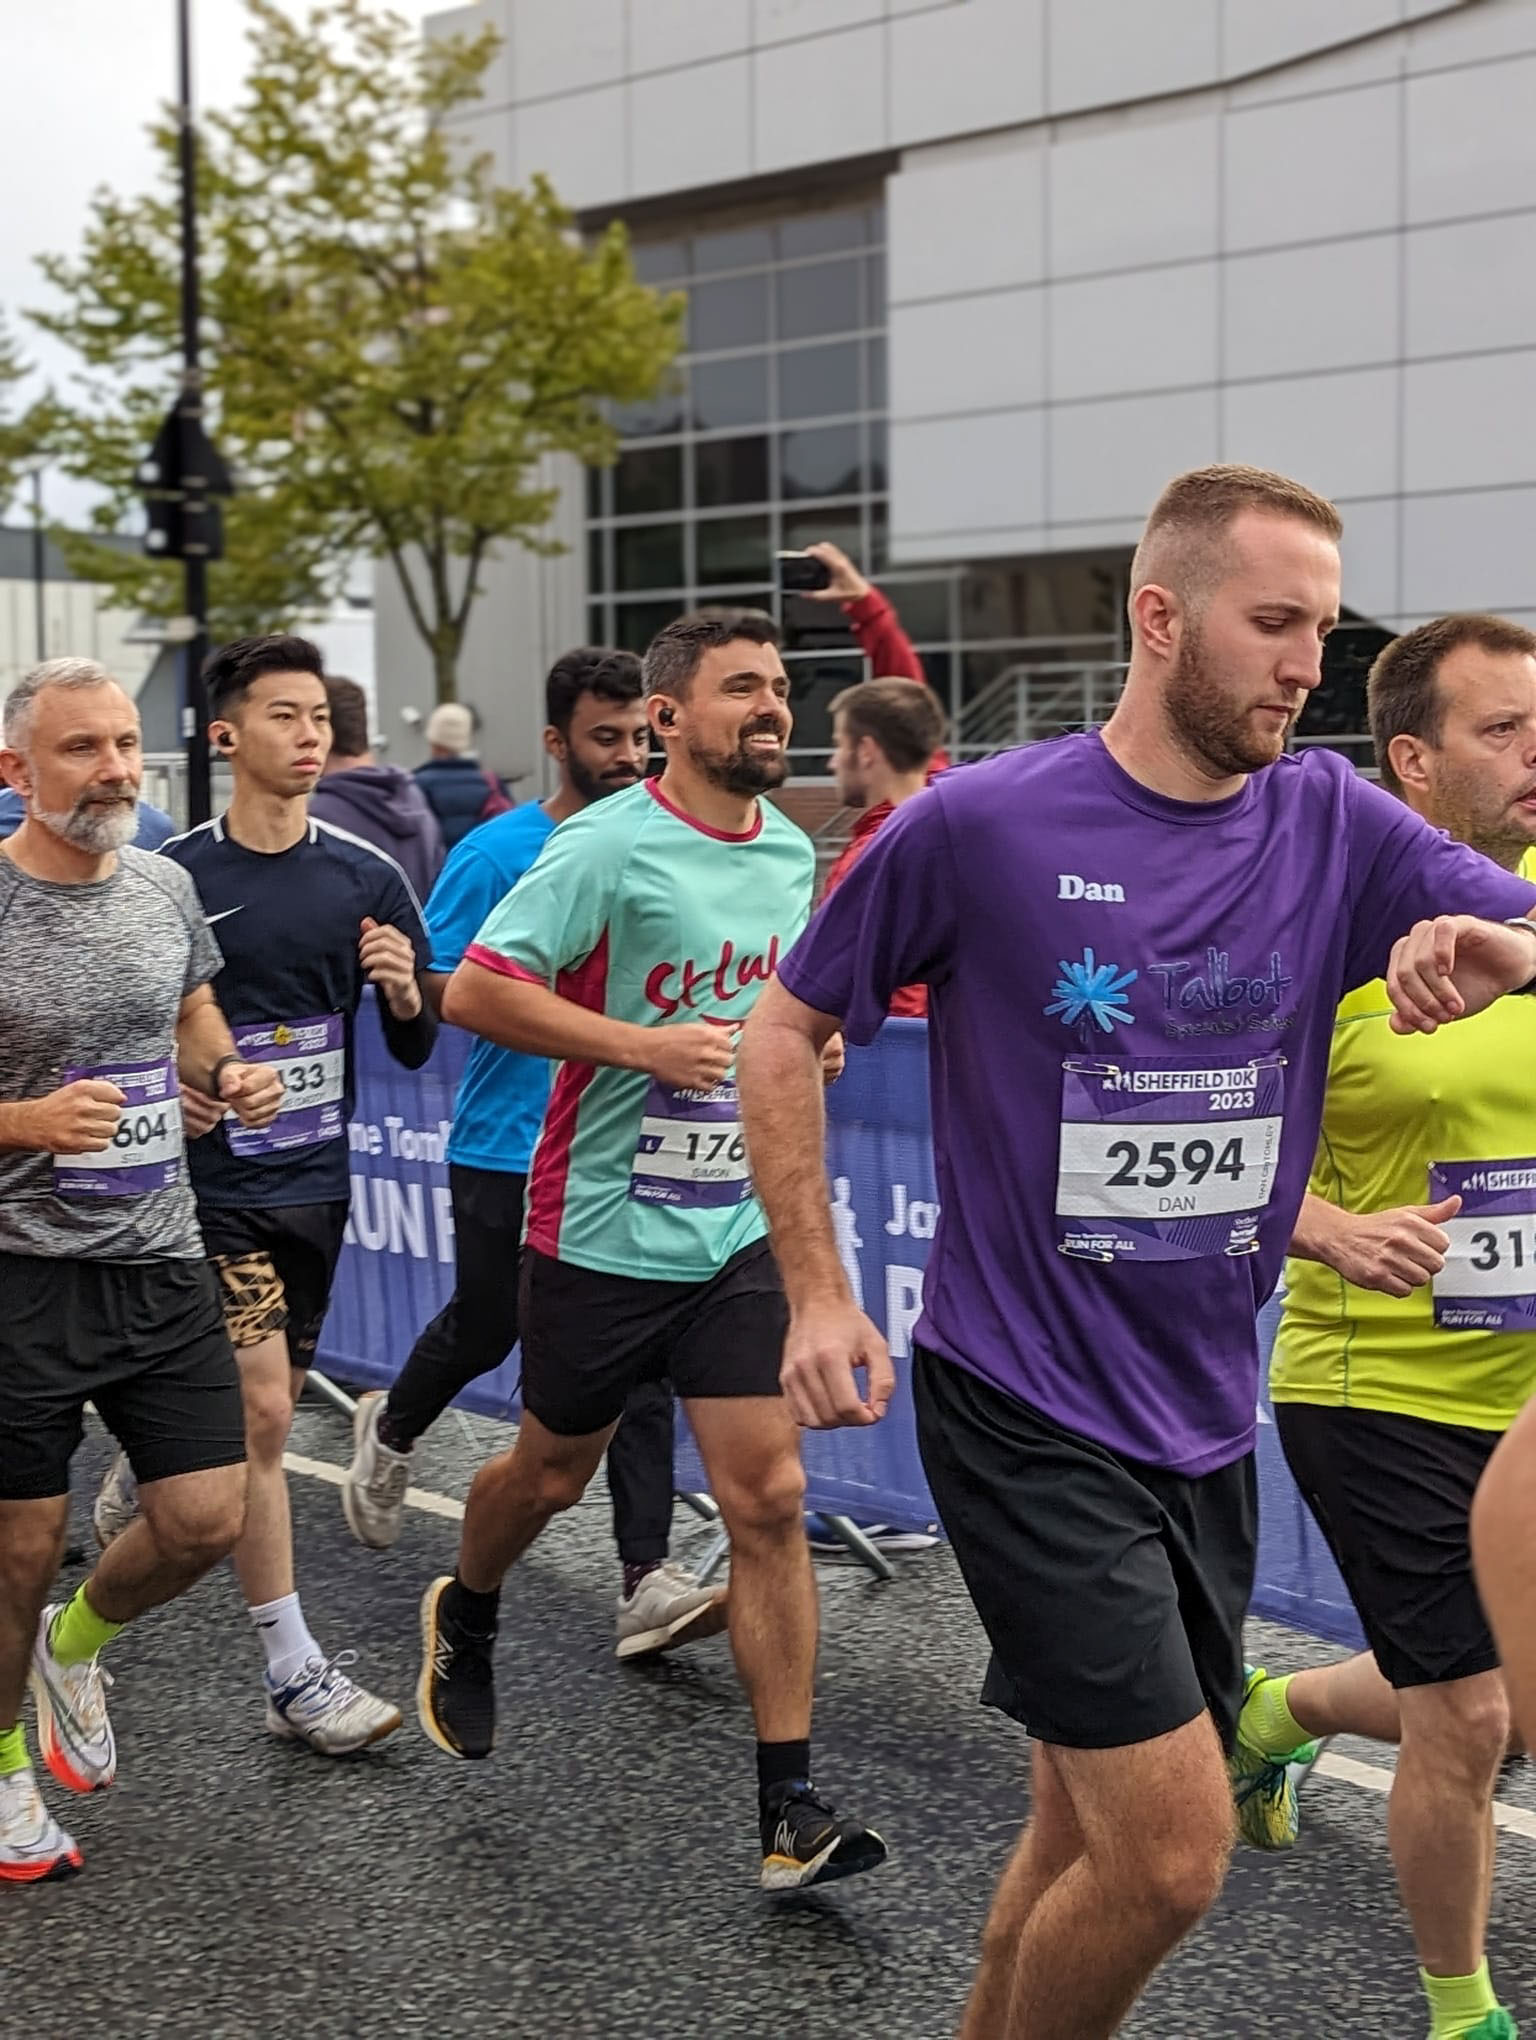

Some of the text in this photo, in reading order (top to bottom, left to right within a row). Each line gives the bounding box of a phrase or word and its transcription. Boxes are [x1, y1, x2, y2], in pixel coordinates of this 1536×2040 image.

[1057, 874, 1126, 903] Dan
[1147, 946, 1293, 1010] Talbot
[1136, 1071, 1255, 1090] SHEFFIELD 10K
[1208, 1092, 1255, 1111] 2023
[1104, 1137, 1245, 1188] 2594
[1158, 1195, 1197, 1213] DAN
[1064, 1238, 1137, 1251] RUN FOR ALL
